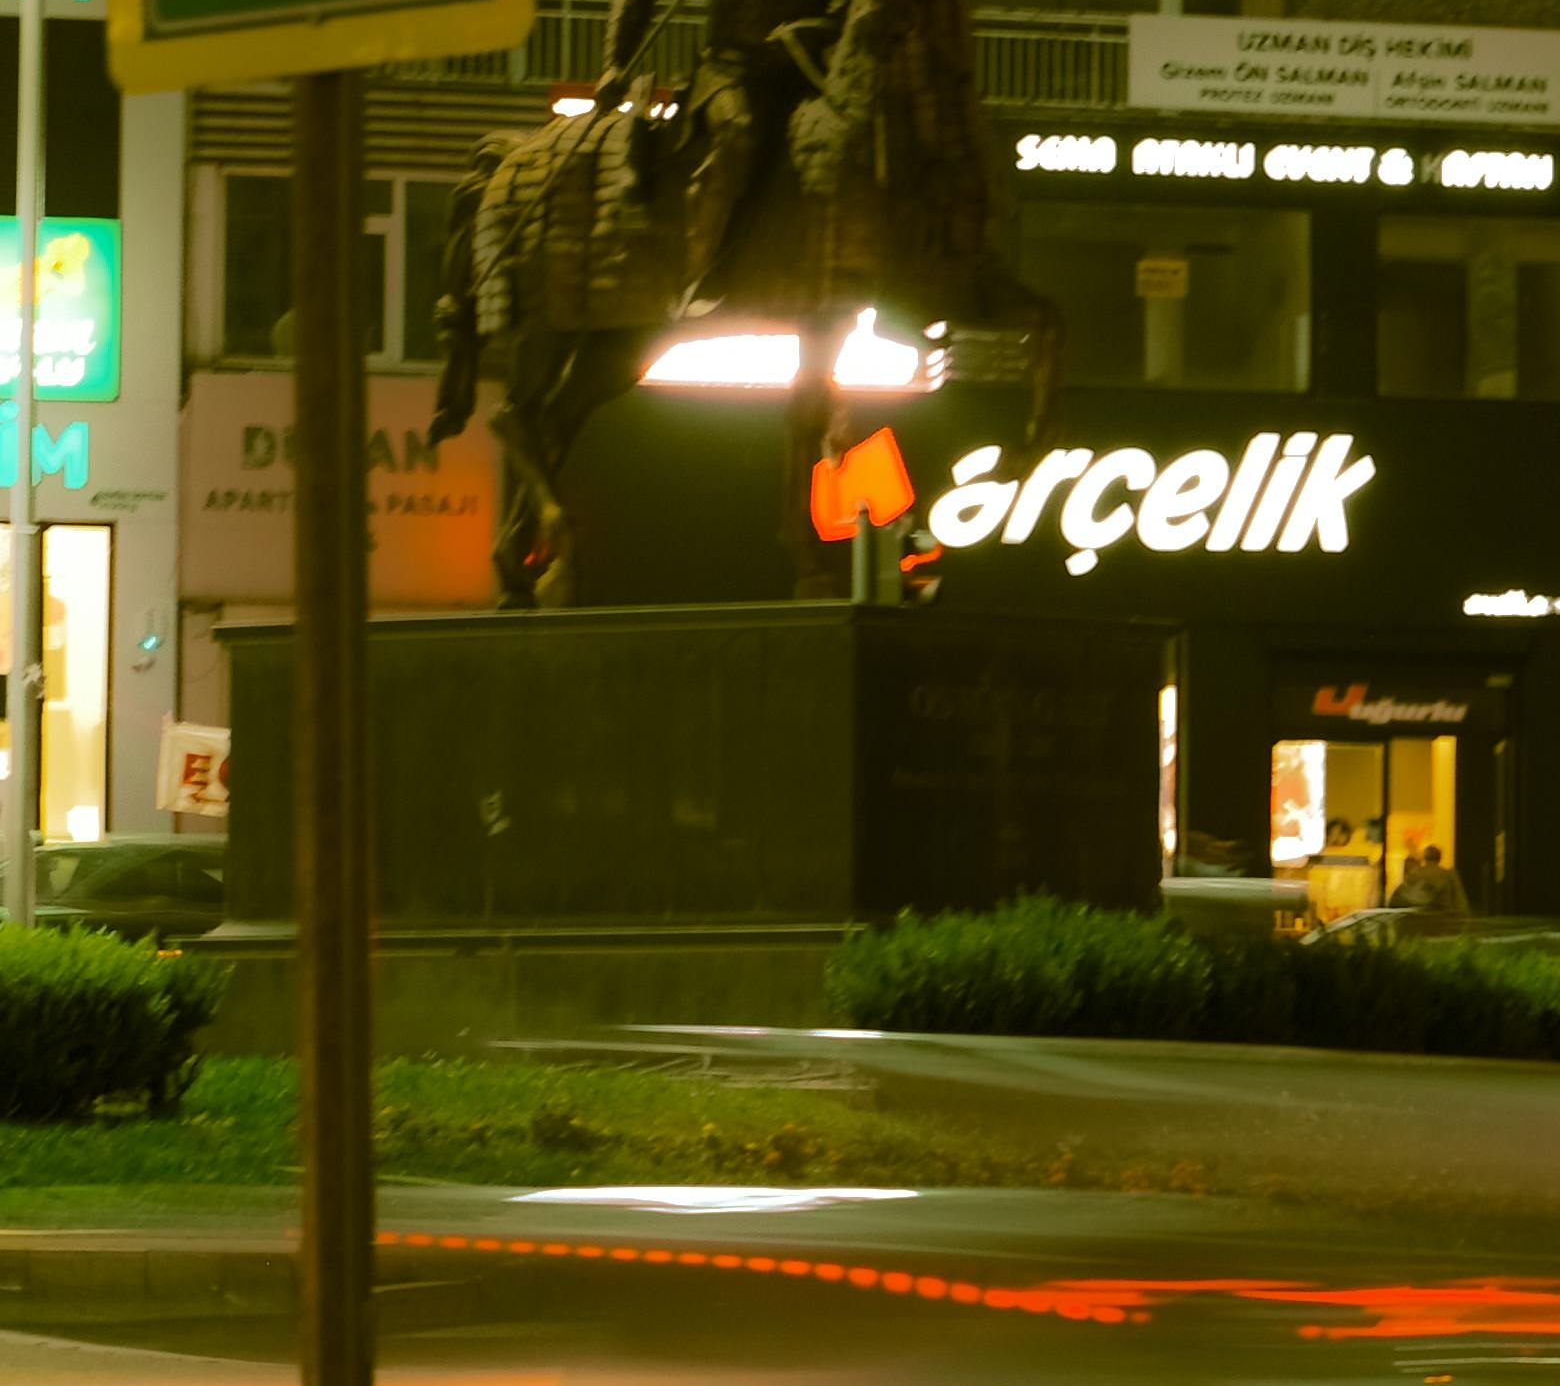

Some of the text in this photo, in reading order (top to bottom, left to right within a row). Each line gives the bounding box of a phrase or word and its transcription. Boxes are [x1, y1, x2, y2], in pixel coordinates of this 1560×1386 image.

[1235, 28, 1475, 62] UZMAN DİŞ HEKİMİ
[1274, 63, 1371, 88] SALMAN
[1454, 72, 1548, 94] SALMAN
[927, 432, 1377, 576] arçelik
